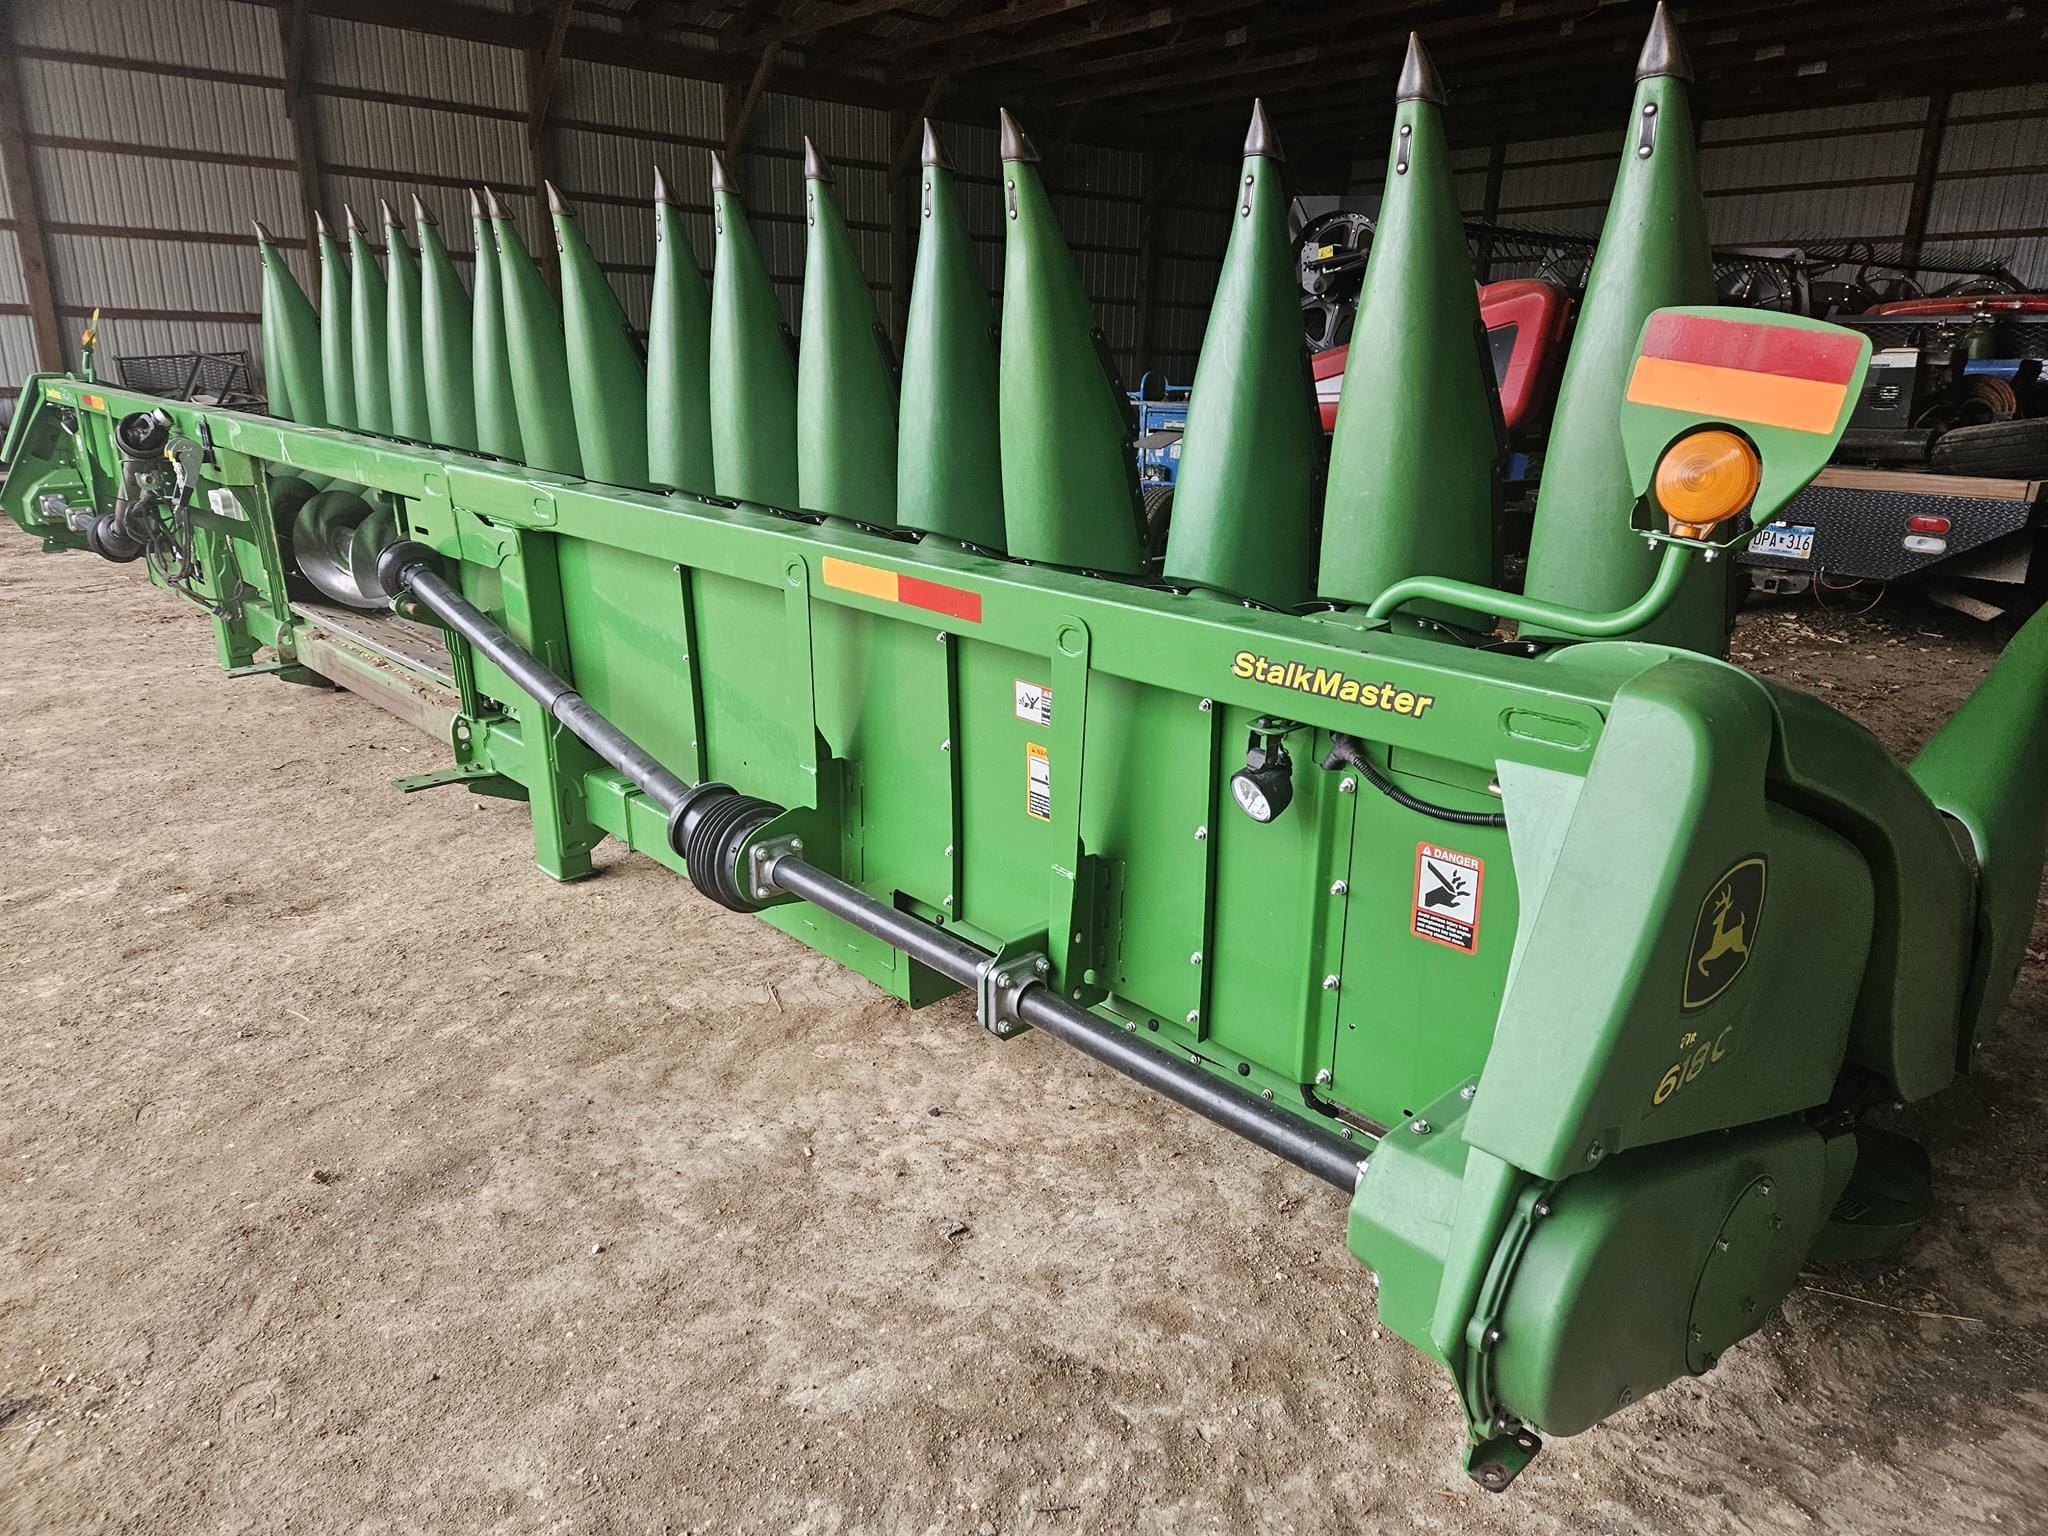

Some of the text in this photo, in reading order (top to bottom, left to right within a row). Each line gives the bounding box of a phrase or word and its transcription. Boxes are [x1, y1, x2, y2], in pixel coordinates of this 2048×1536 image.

[1786, 533, 1810, 551] 316
[1233, 651, 1436, 719] StalkMaster
[1434, 848, 1480, 870] DANGER
[1653, 1024, 1734, 1105] 618C
